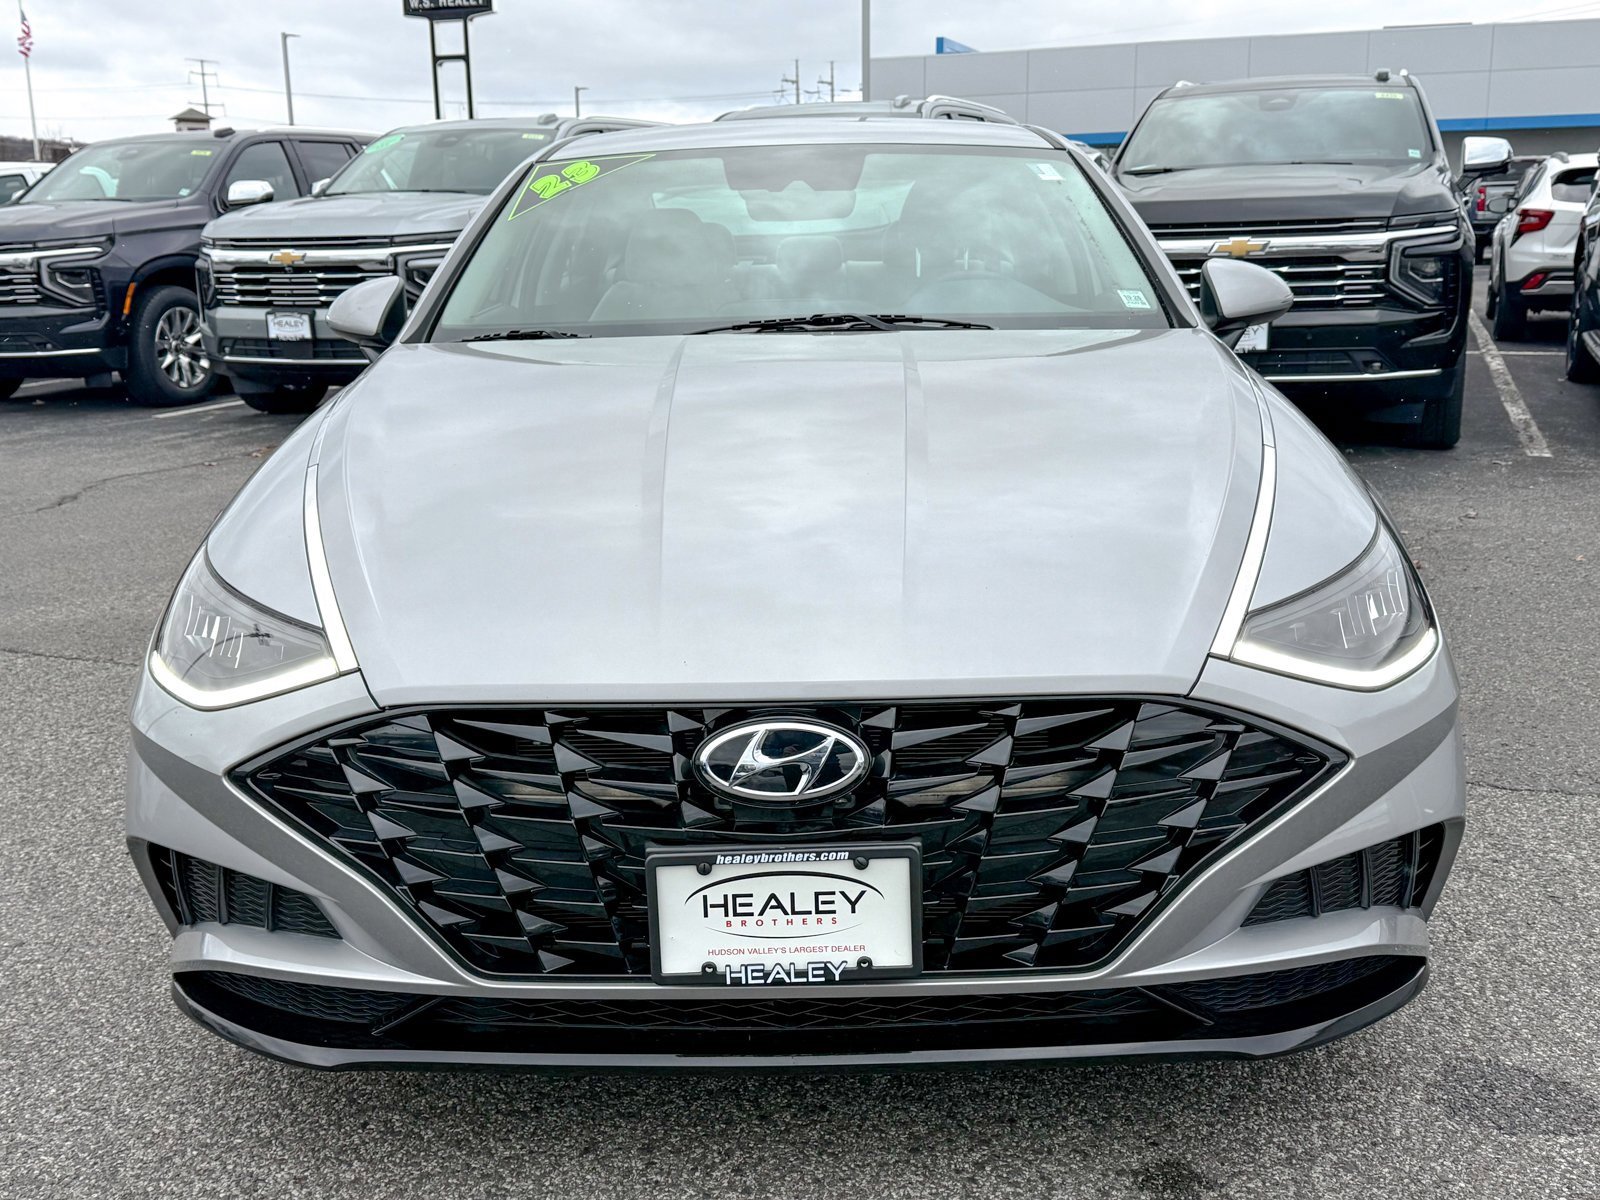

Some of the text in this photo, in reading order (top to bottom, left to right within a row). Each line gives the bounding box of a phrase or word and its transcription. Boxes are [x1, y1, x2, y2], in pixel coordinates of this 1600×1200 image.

[438, 0, 484, 8] HEALEY
[529, 160, 601, 199] 23
[273, 319, 304, 328] HEALEY
[716, 851, 850, 865] healeybrothers.com
[702, 890, 867, 918] HEALEY
[725, 917, 838, 928] BROTHERS
[707, 944, 866, 956] HUDSON VALLEY'S LARGEST DEALER
[724, 960, 848, 985] HEALEY
